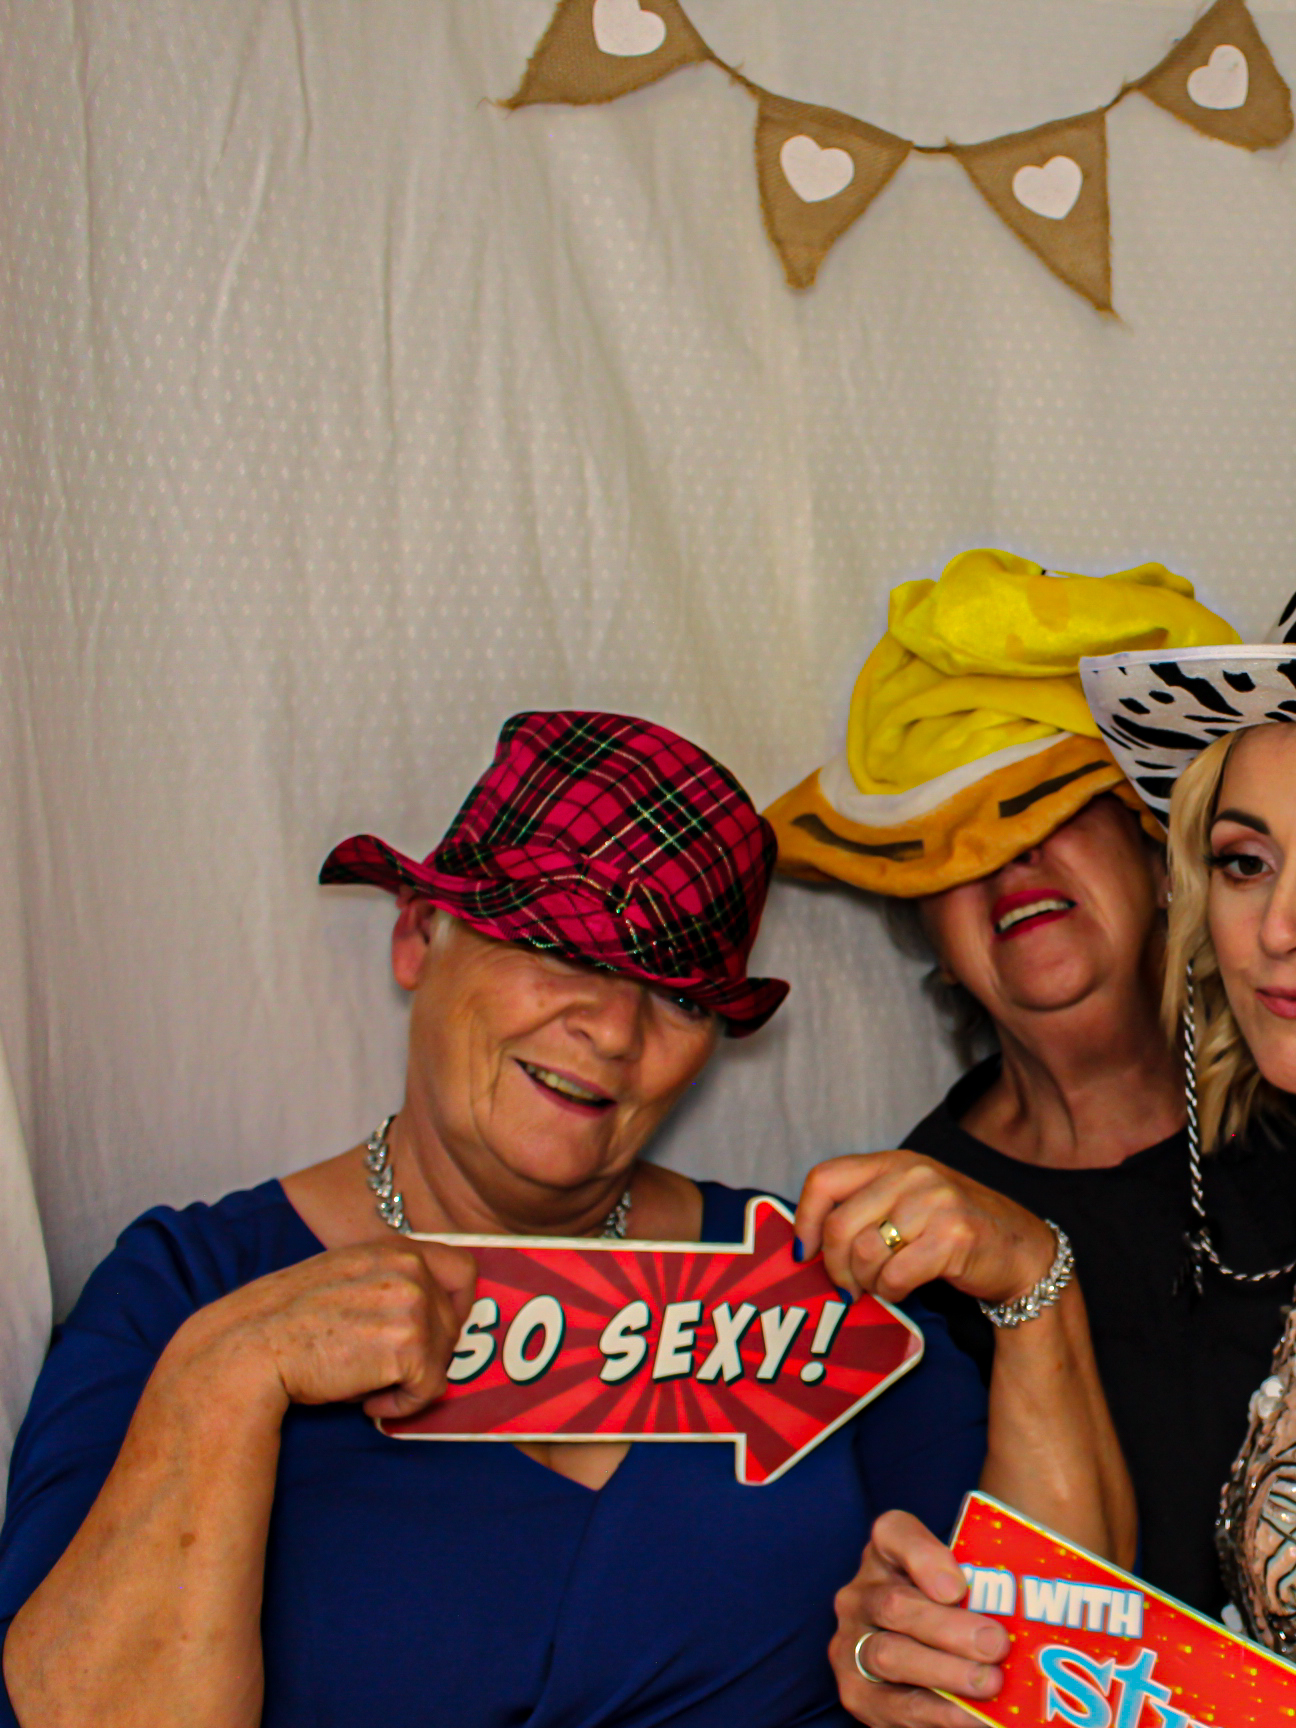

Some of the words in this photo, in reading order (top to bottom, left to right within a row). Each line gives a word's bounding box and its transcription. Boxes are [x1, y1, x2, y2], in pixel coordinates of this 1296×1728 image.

[446, 1295, 565, 1383] SO
[599, 1299, 847, 1386] SEXY!
[1023, 1575, 1144, 1638] WITH
